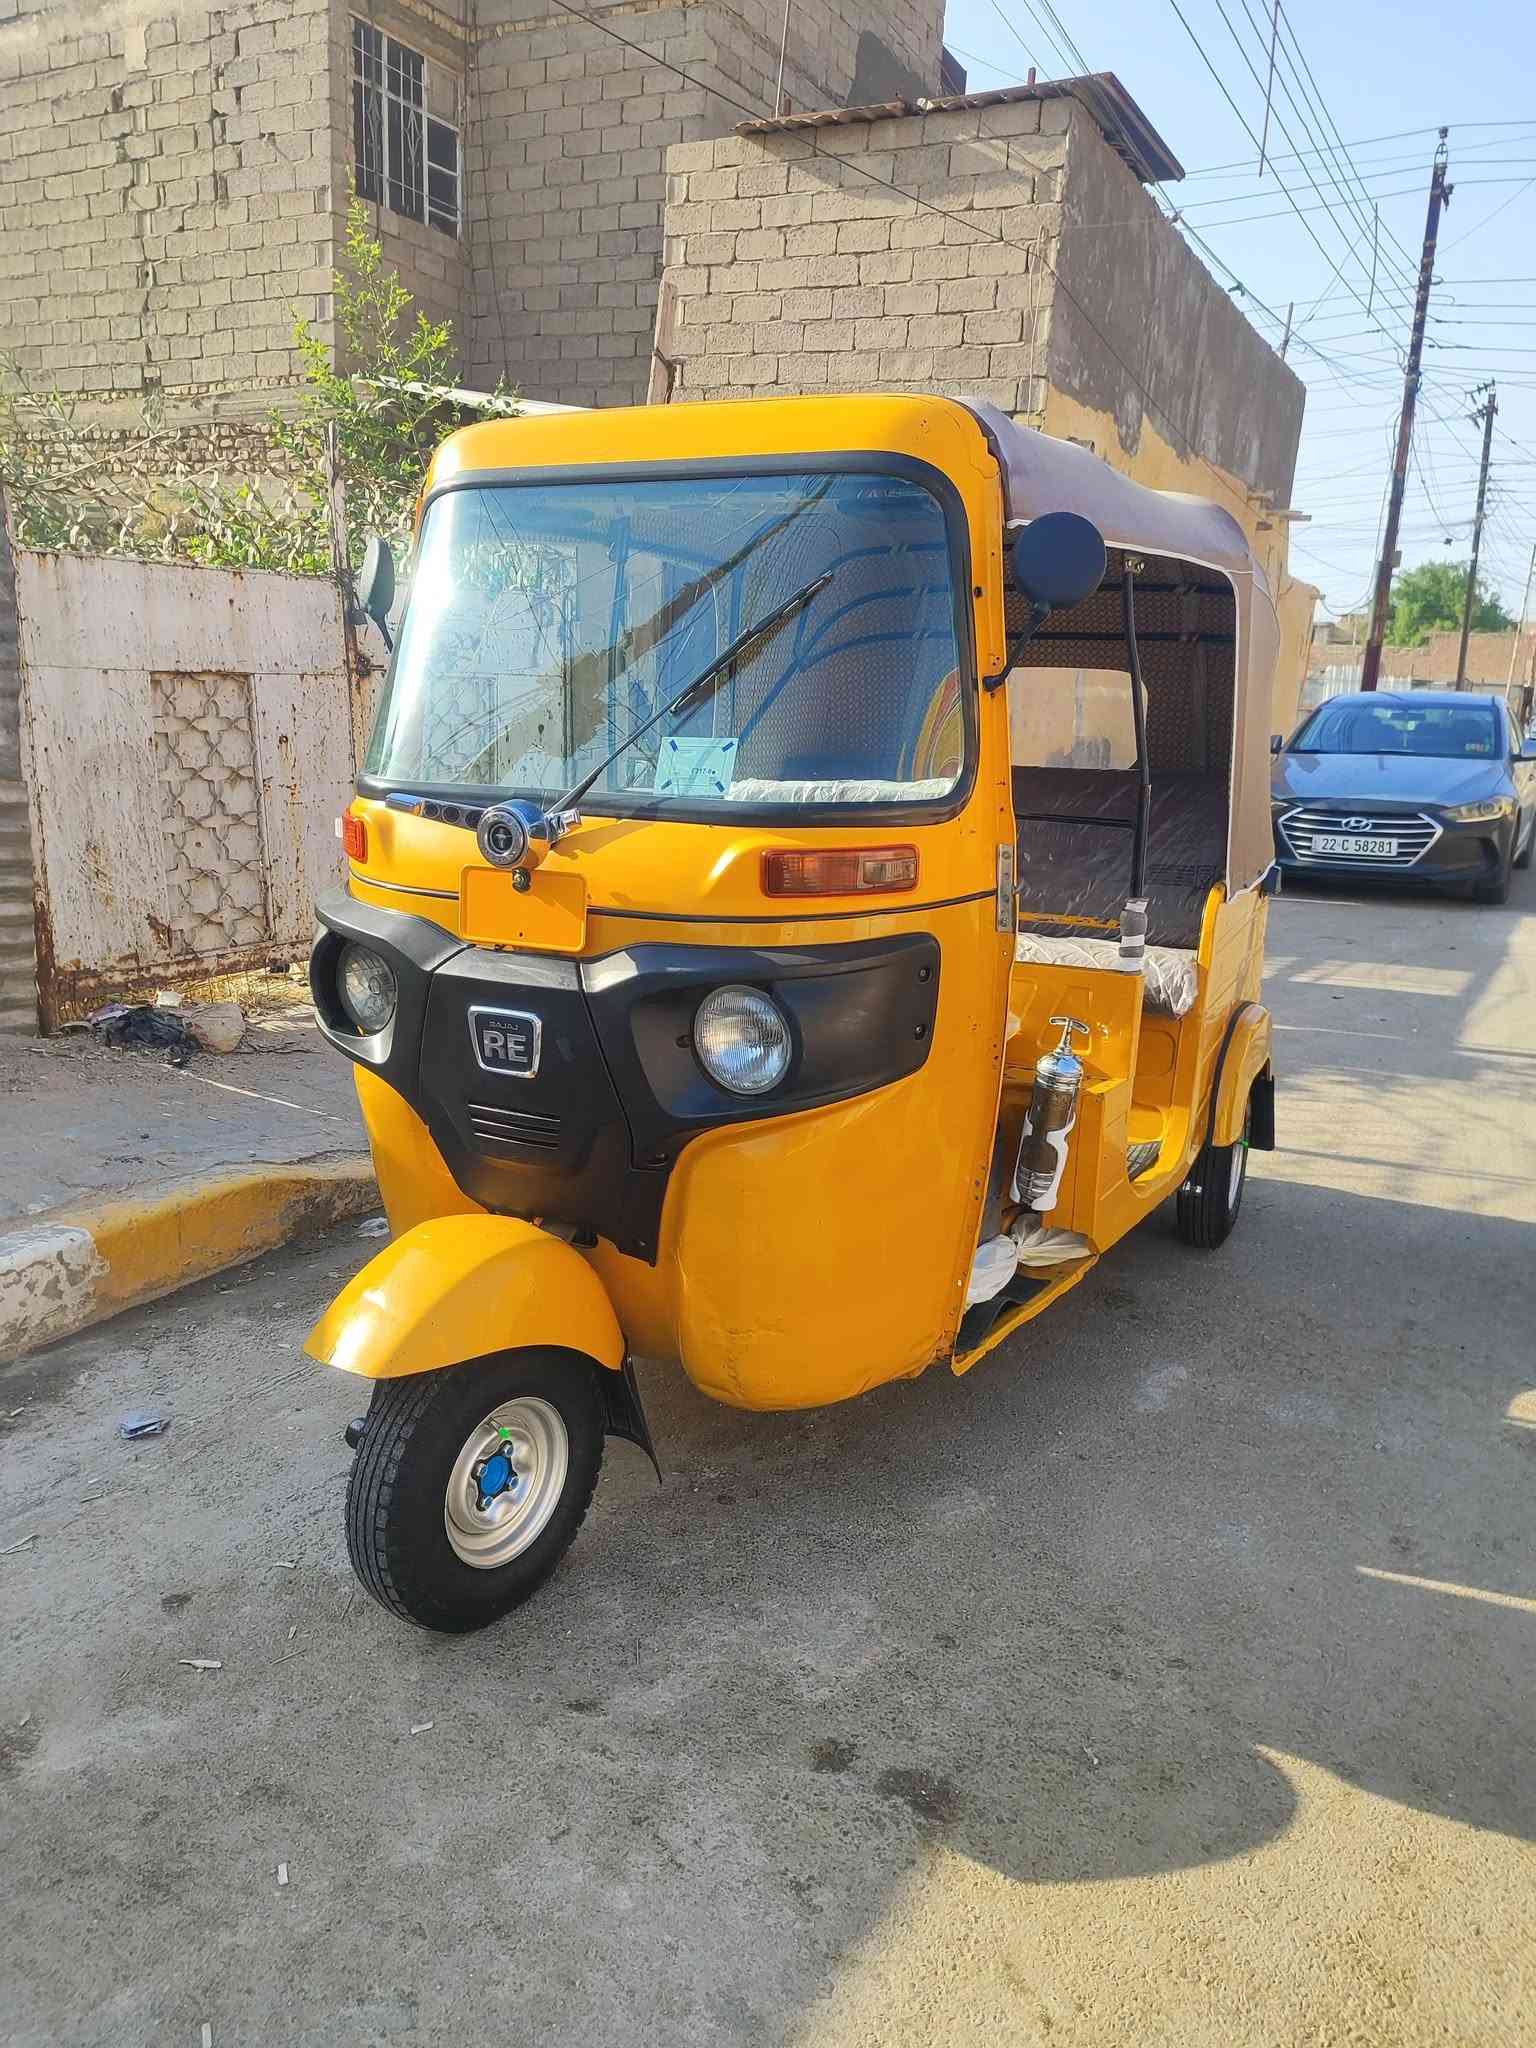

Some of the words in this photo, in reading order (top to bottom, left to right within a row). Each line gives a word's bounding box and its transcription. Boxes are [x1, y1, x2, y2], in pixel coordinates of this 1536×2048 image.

[1322, 838, 1336, 851] 22
[1342, 839, 1349, 851] C
[1354, 840, 1392, 854] 58281
[483, 1030, 528, 1063] RE
